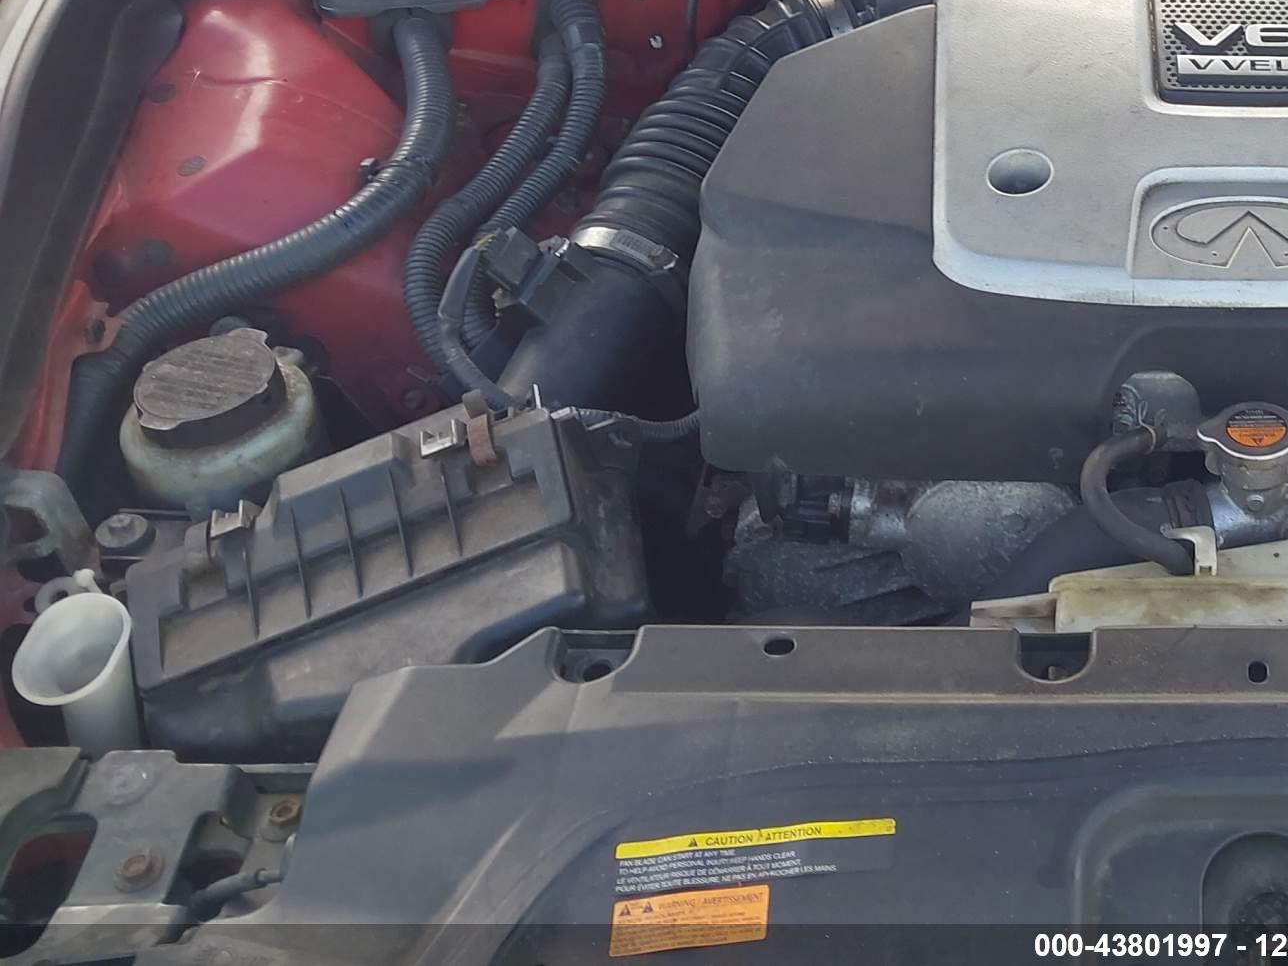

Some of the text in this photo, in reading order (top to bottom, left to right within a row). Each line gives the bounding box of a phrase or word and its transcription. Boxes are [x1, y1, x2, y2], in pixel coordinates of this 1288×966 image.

[705, 835, 754, 847] CAUTION
[766, 827, 823, 842] ATTENTION
[615, 884, 636, 893] POUR
